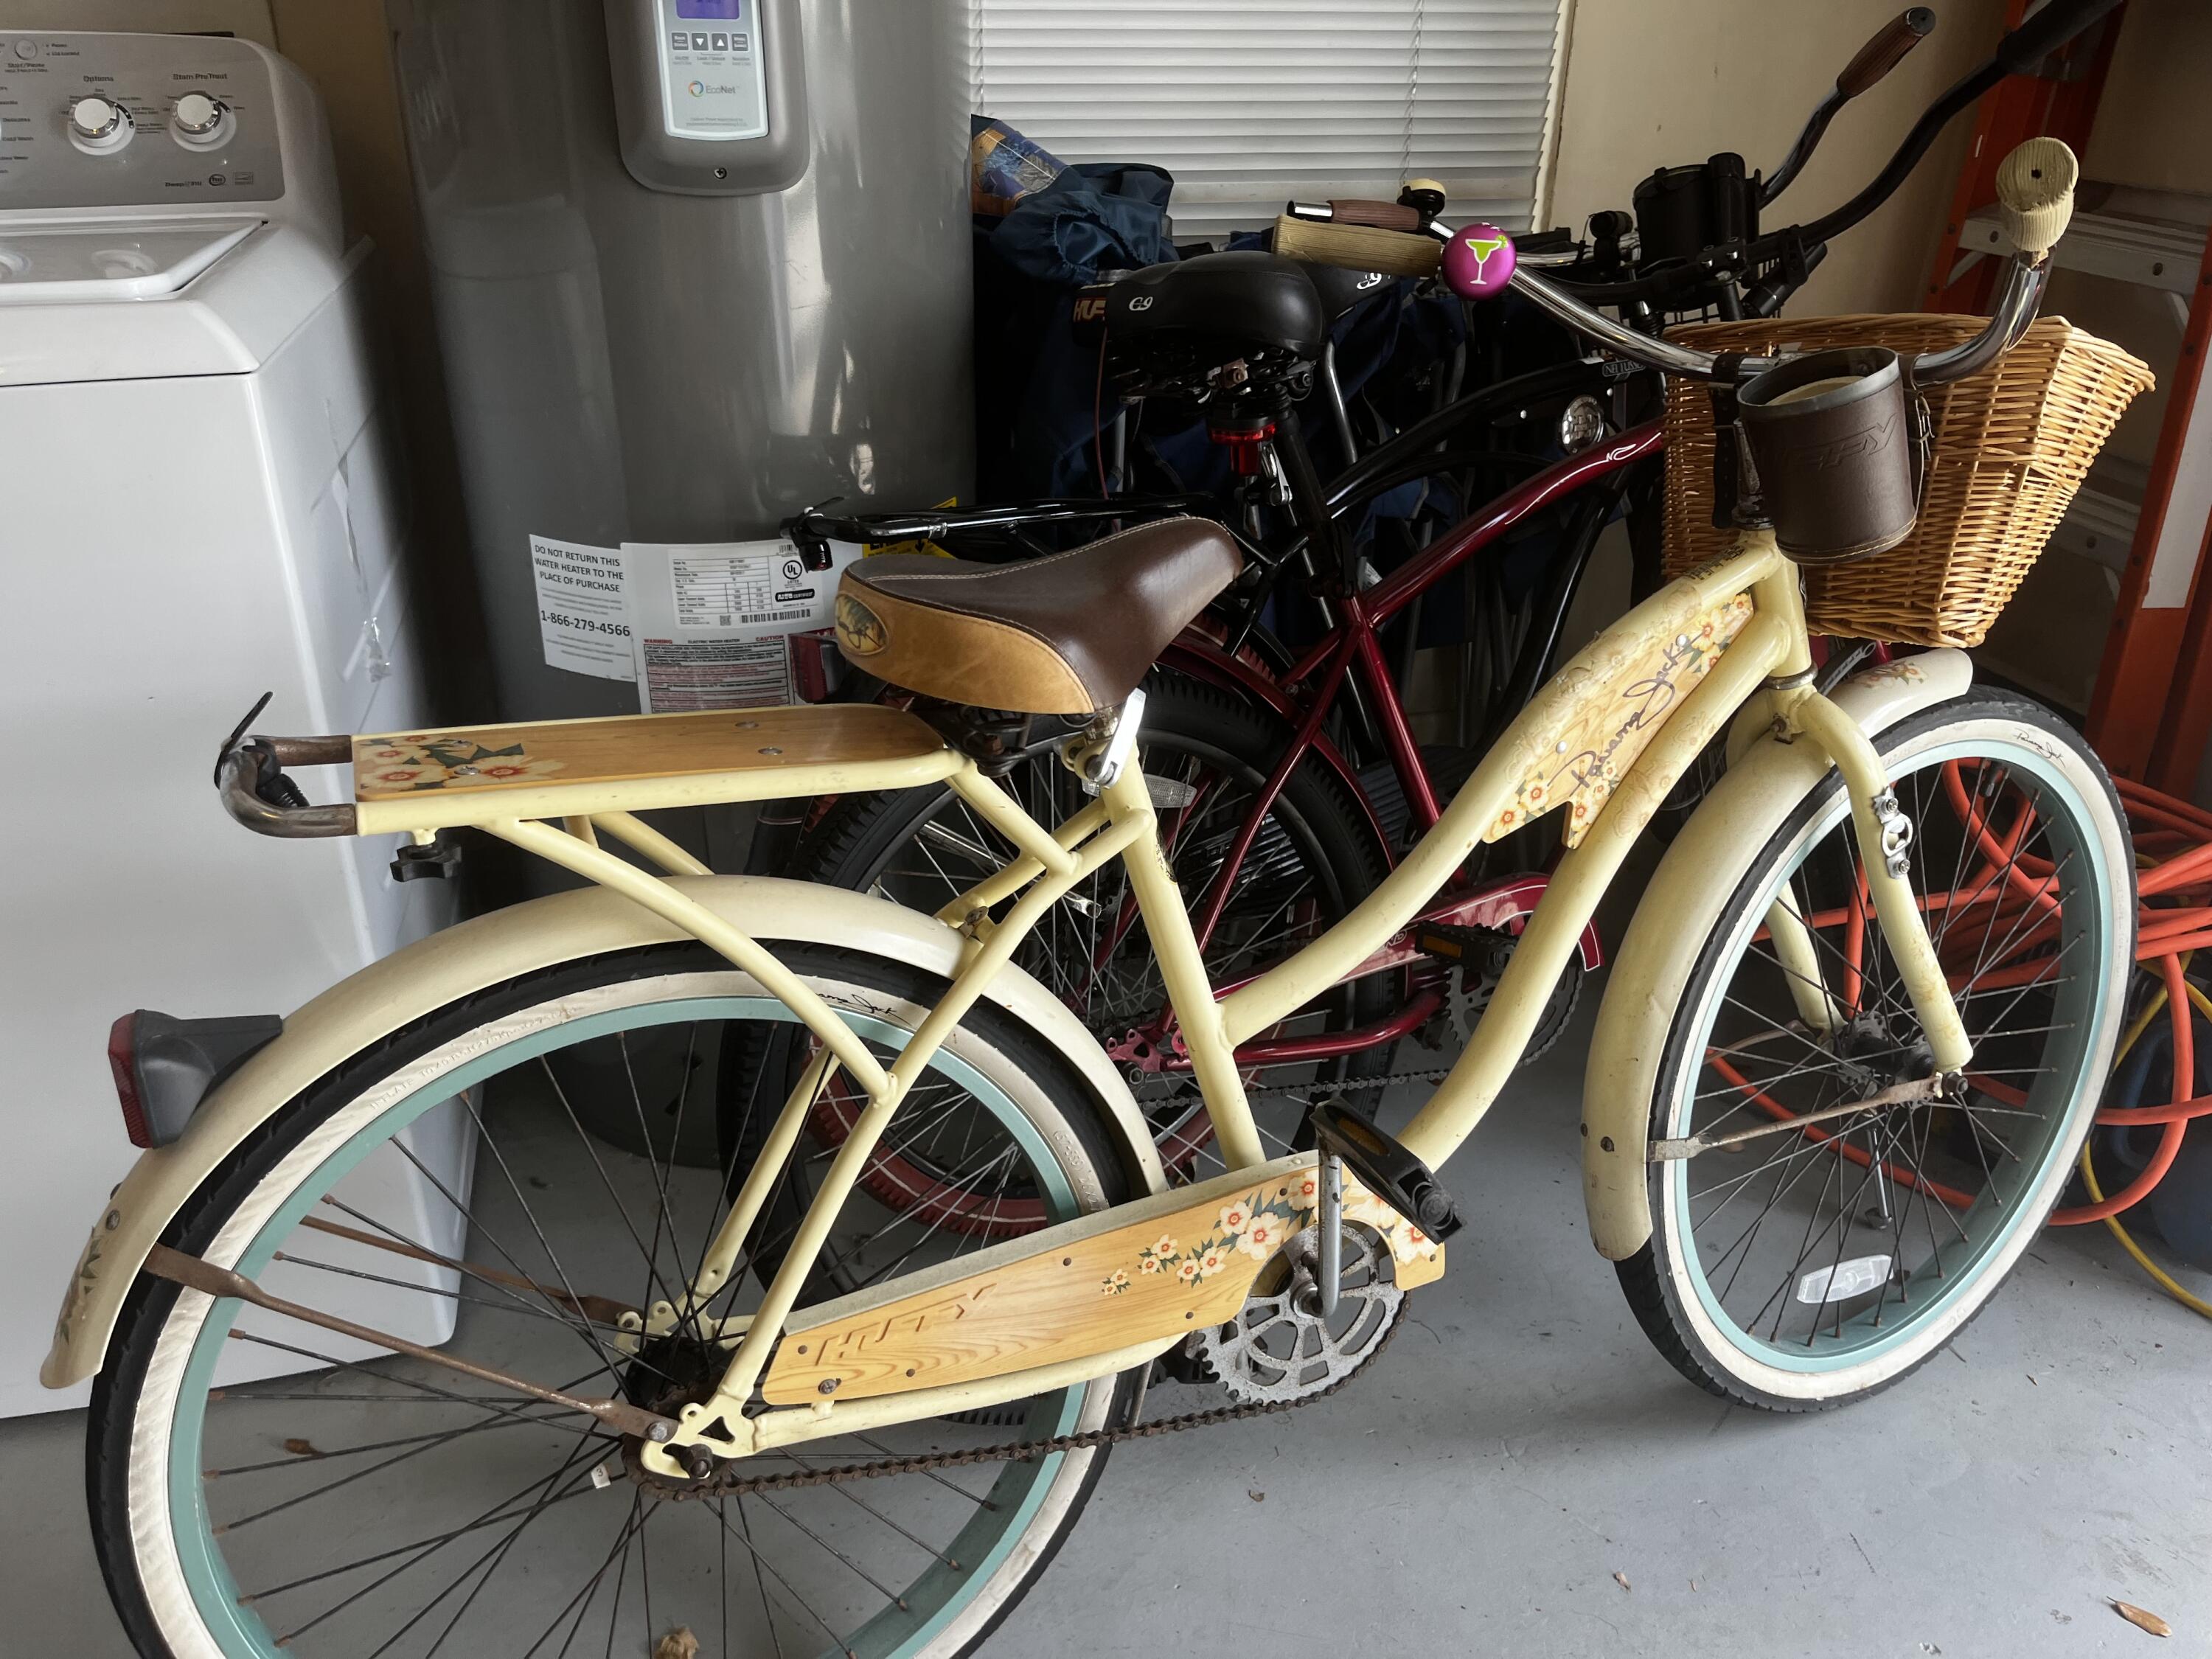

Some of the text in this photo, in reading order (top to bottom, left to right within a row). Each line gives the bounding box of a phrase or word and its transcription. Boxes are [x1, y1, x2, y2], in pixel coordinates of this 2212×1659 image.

[706, 85, 737, 94] EcoNet
[535, 545, 620, 567] DO NOT RETURN THIS
[535, 557, 624, 580] WATER HEATER TO THE
[540, 571, 620, 592] PLACE OF PURCHASE
[541, 610, 630, 637] 1-866-279-4566
